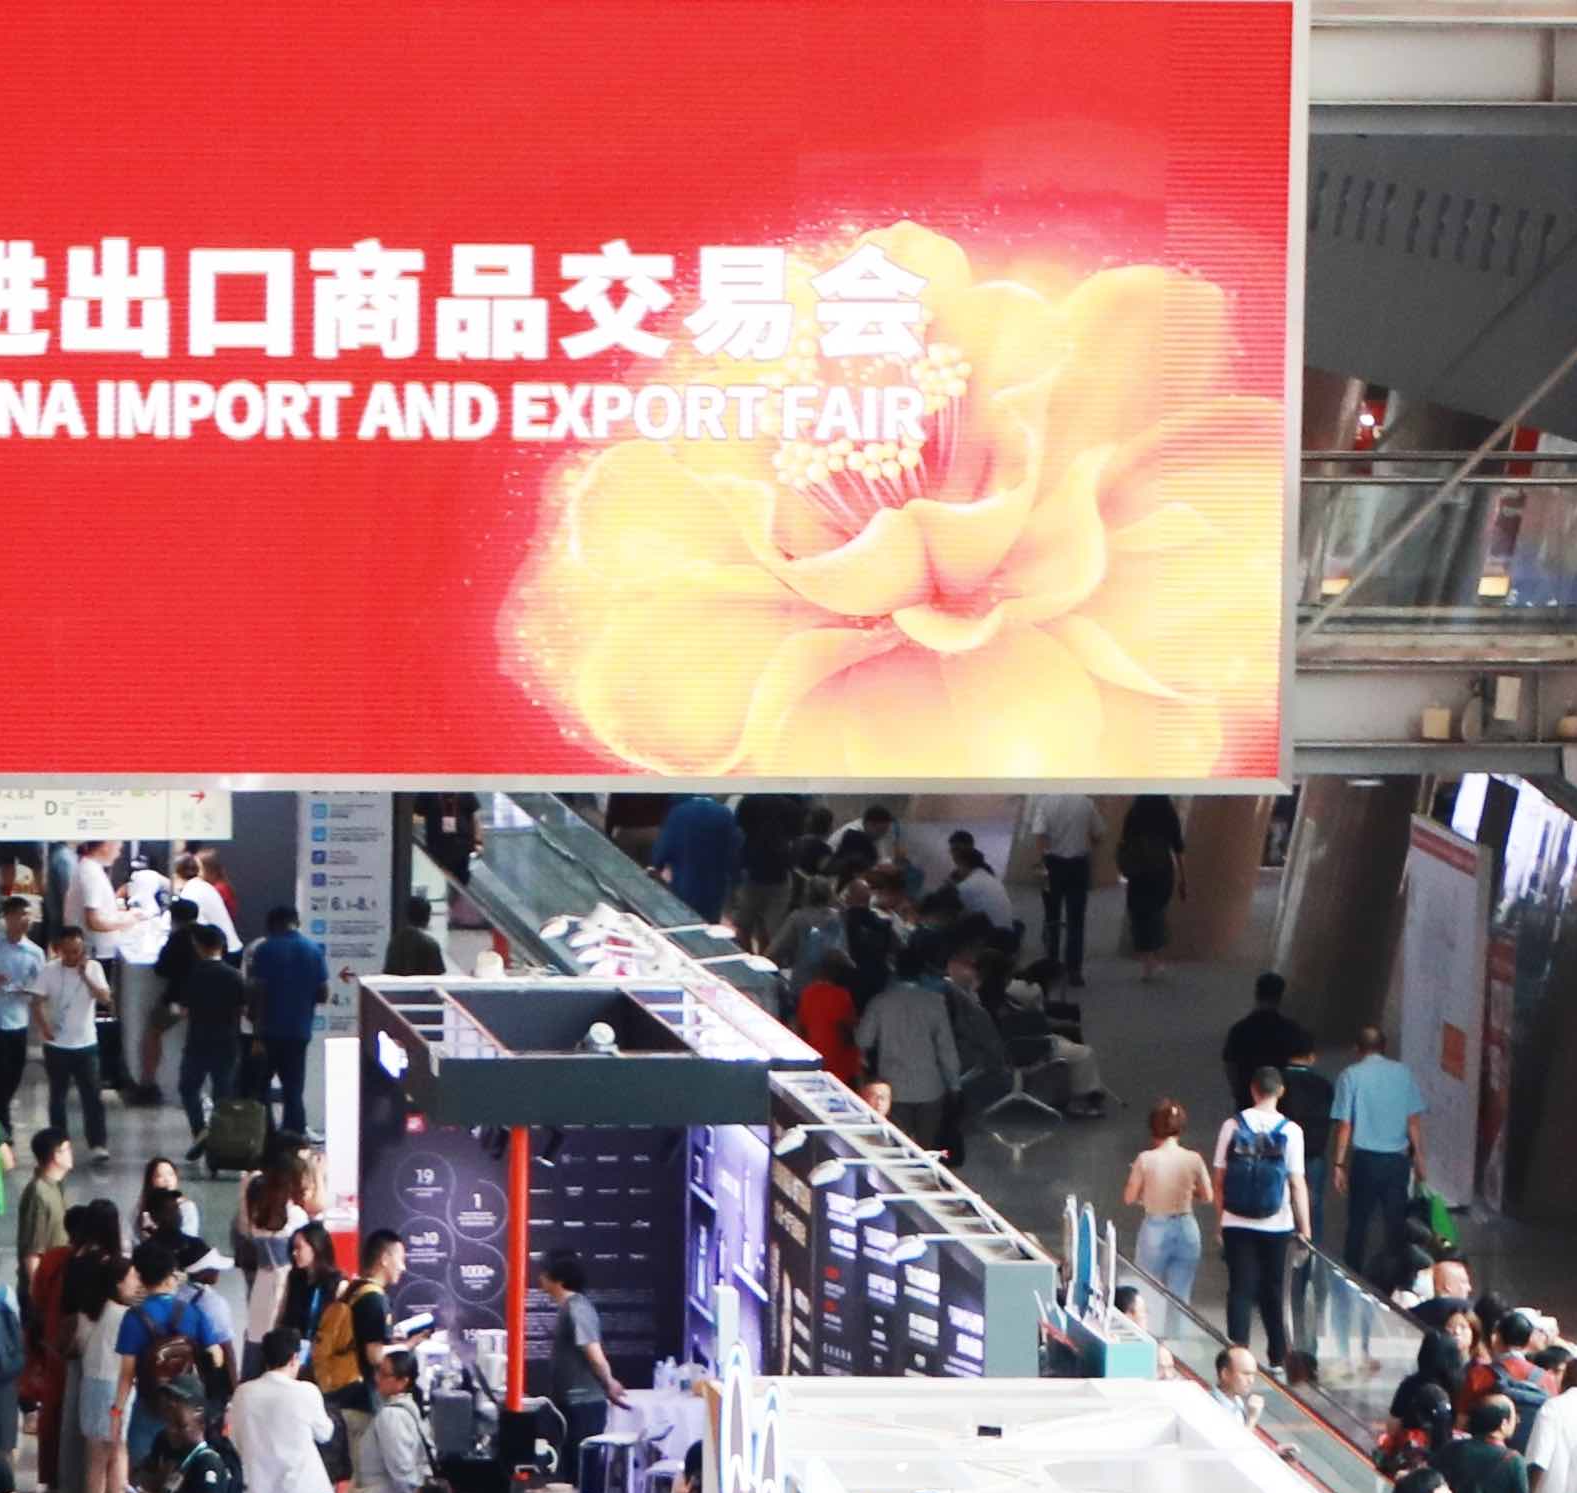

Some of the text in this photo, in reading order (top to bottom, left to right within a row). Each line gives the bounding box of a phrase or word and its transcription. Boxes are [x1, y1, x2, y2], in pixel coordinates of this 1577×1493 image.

[97, 380, 353, 440] IMPORT
[364, 382, 497, 440] AND
[511, 382, 763, 441] EXPORT
[783, 385, 926, 441] FAIR
